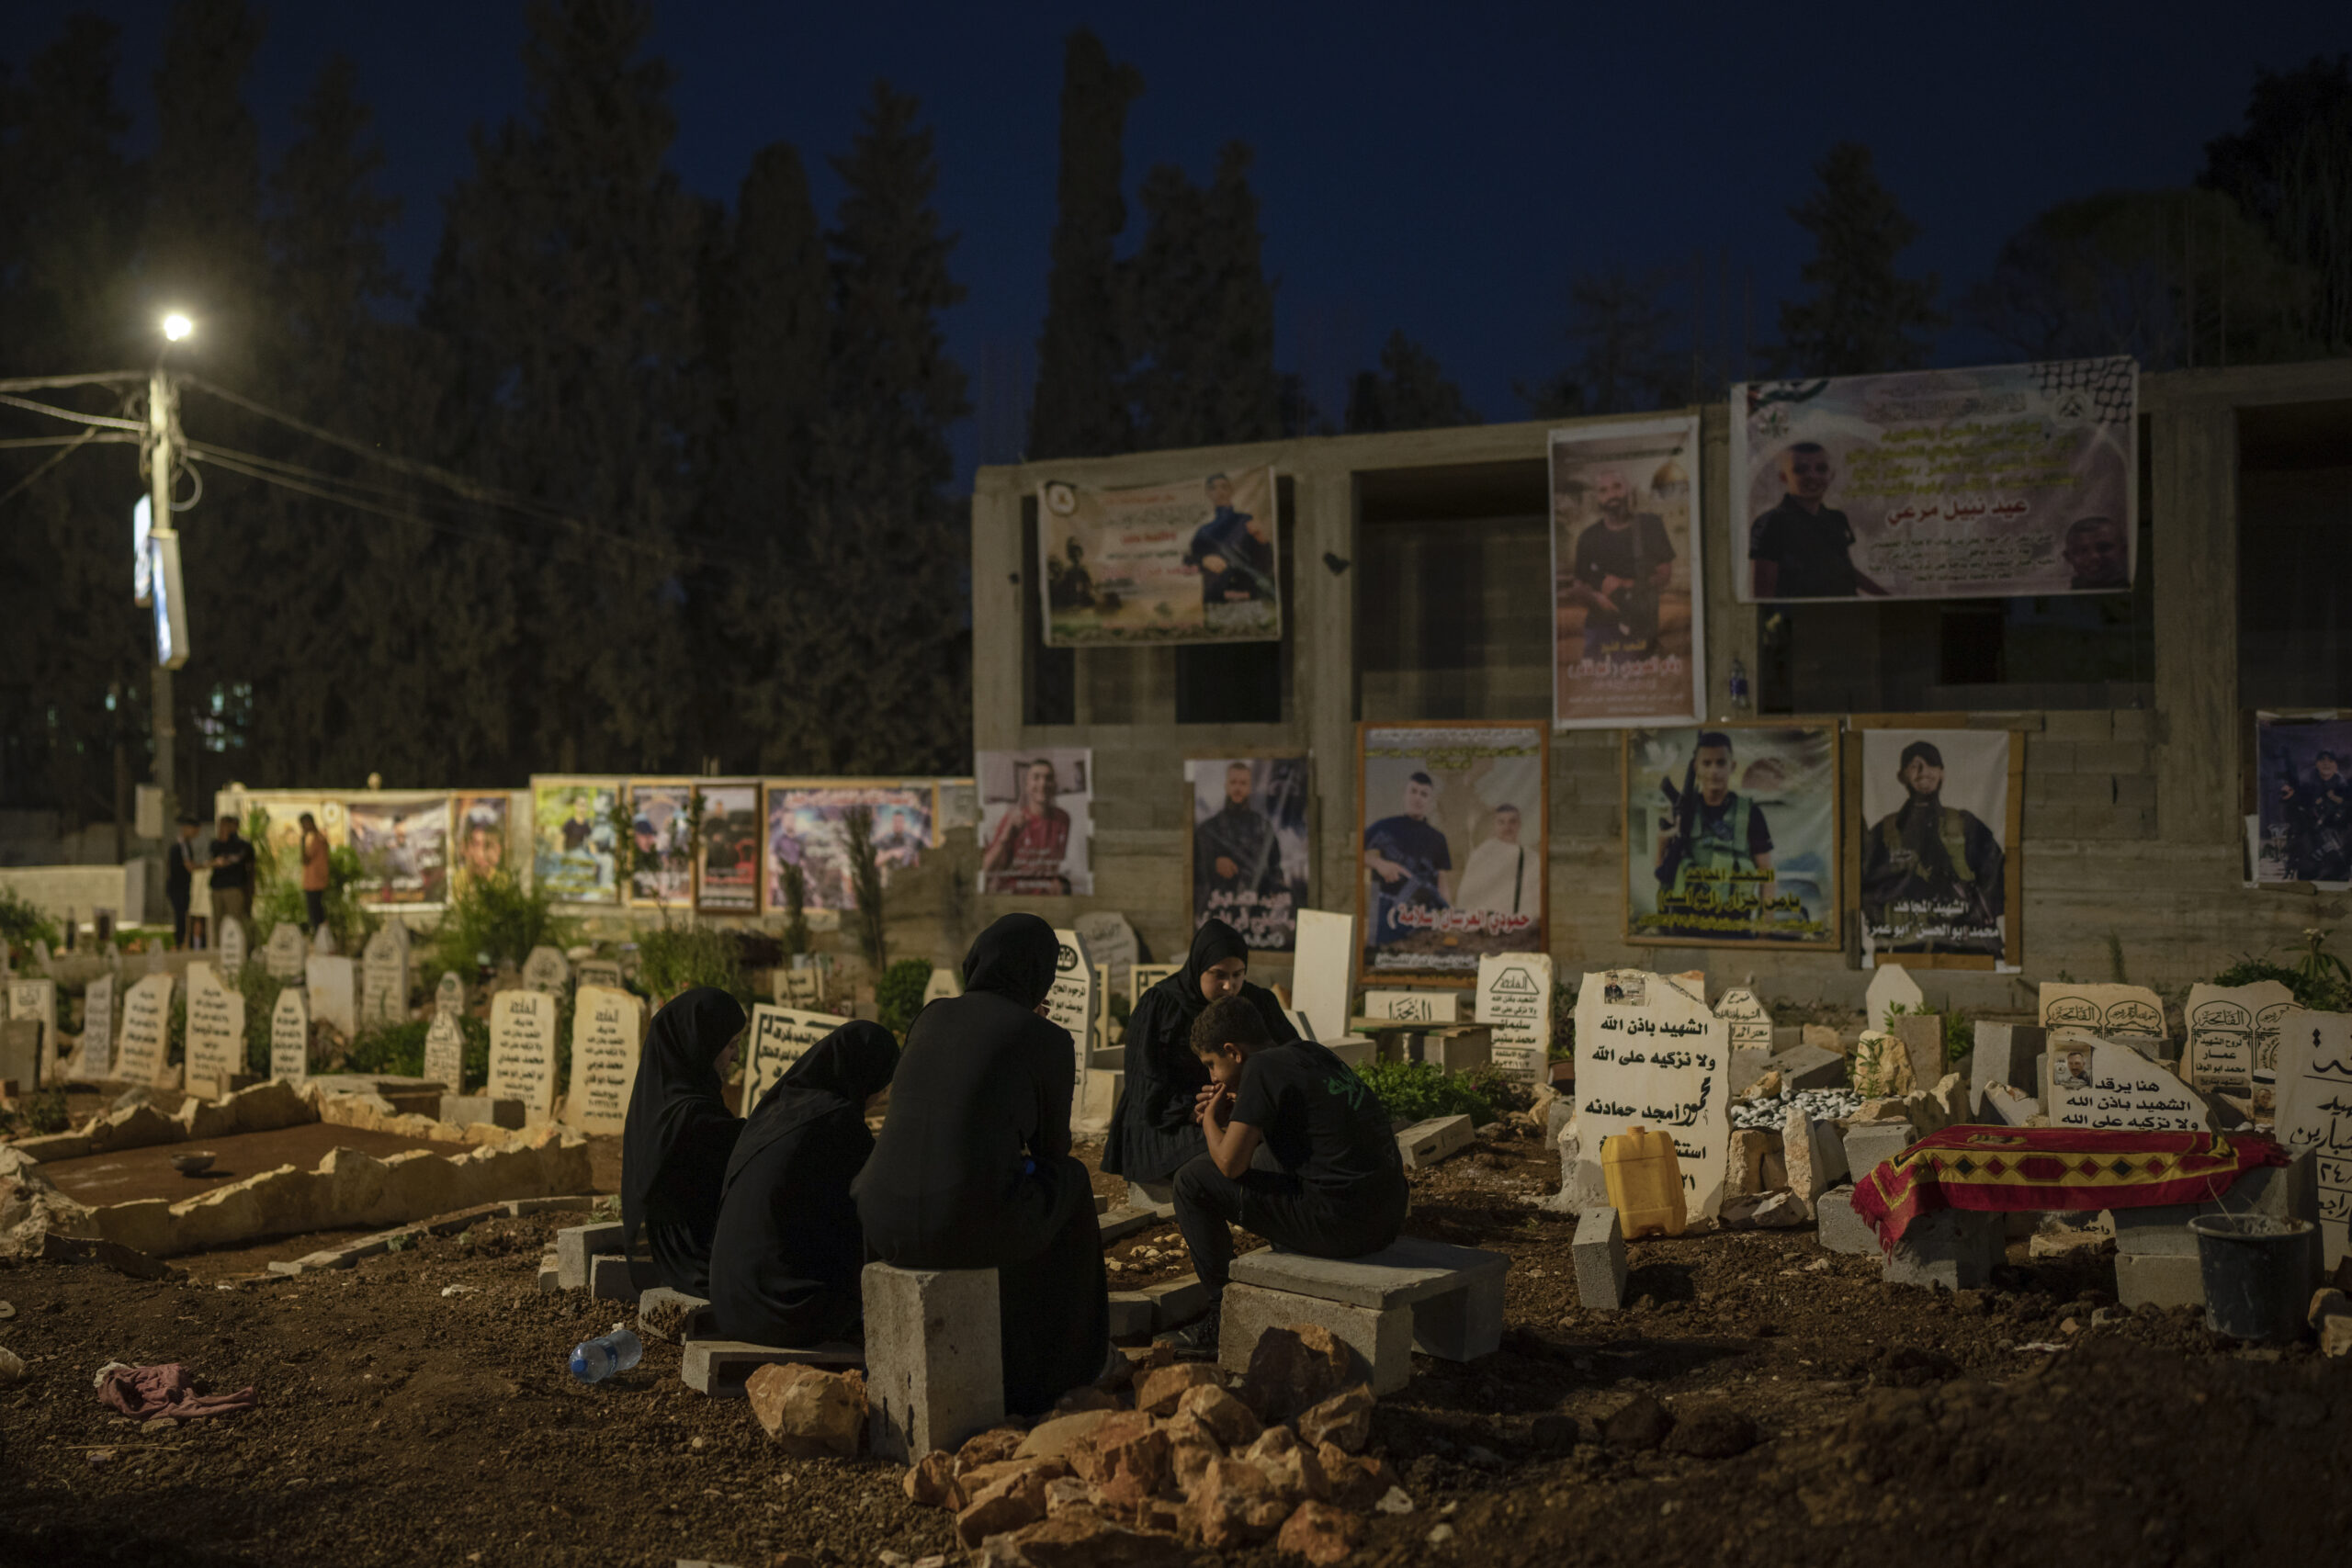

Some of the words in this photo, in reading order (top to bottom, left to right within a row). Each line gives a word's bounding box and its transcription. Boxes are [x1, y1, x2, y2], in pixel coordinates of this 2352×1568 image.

[1887, 505, 1939, 525] مرعي
[1944, 497, 1985, 521] نبيل
[1990, 501, 2027, 520] عيد
[1892, 898, 1931, 917] المجاهد
[1931, 898, 1968, 917] الشهيد
[1915, 921, 1949, 939] الحسن
[1967, 926, 1998, 938] محمد
[2051, 1005, 2095, 1021] الفاتحة
[2197, 1009, 2244, 1028] الفاتحة
[1600, 1015, 1623, 1031] الله
[1627, 1017, 1656, 1037] باذن
[1659, 1018, 1708, 1038] الشهيد
[2199, 1036, 2223, 1046] الشهيد
[1592, 1045, 1615, 1061] الله
[1619, 1049, 1645, 1066] على
[1650, 1051, 1691, 1069] نزكيه
[1696, 1054, 1716, 1071] ولا
[2095, 1077, 2132, 1093] يرقد
[2136, 1081, 2159, 1092] هنا
[2066, 1096, 2093, 1107] الله
[2097, 1097, 2132, 1111] باذن
[2136, 1099, 2190, 1112] الشهيد
[2062, 1114, 2088, 1125] الله
[2092, 1115, 2123, 1128] على
[2175, 1118, 2199, 1131] ولا
